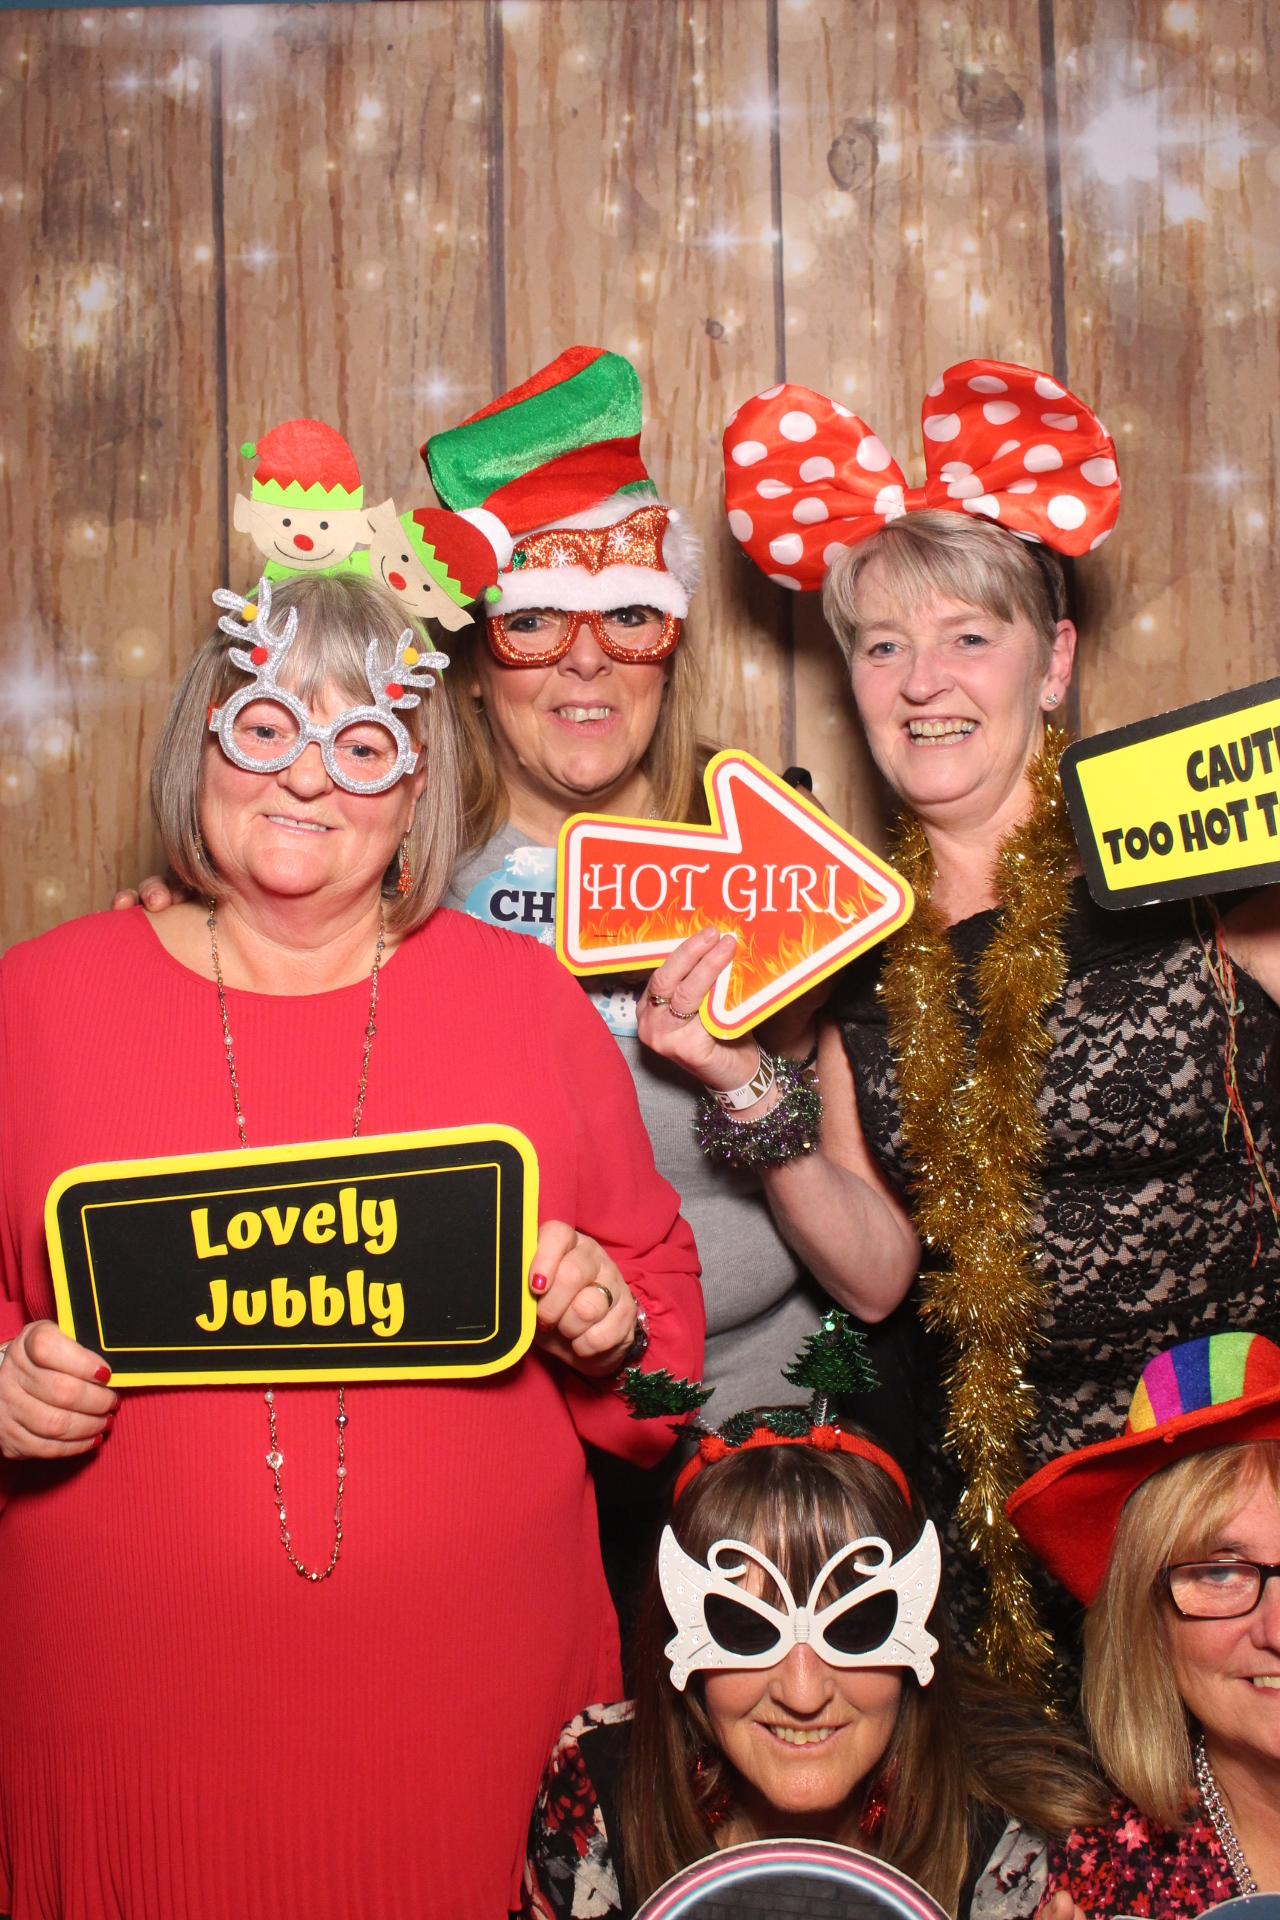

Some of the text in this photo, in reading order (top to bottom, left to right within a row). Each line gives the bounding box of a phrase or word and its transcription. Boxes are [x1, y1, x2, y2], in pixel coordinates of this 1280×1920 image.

[1102, 791, 1280, 865] TOO HOT T
[583, 863, 856, 924] HOT GIRL
[191, 1187, 398, 1259] Lovely
[195, 1270, 405, 1337] Jubbly
